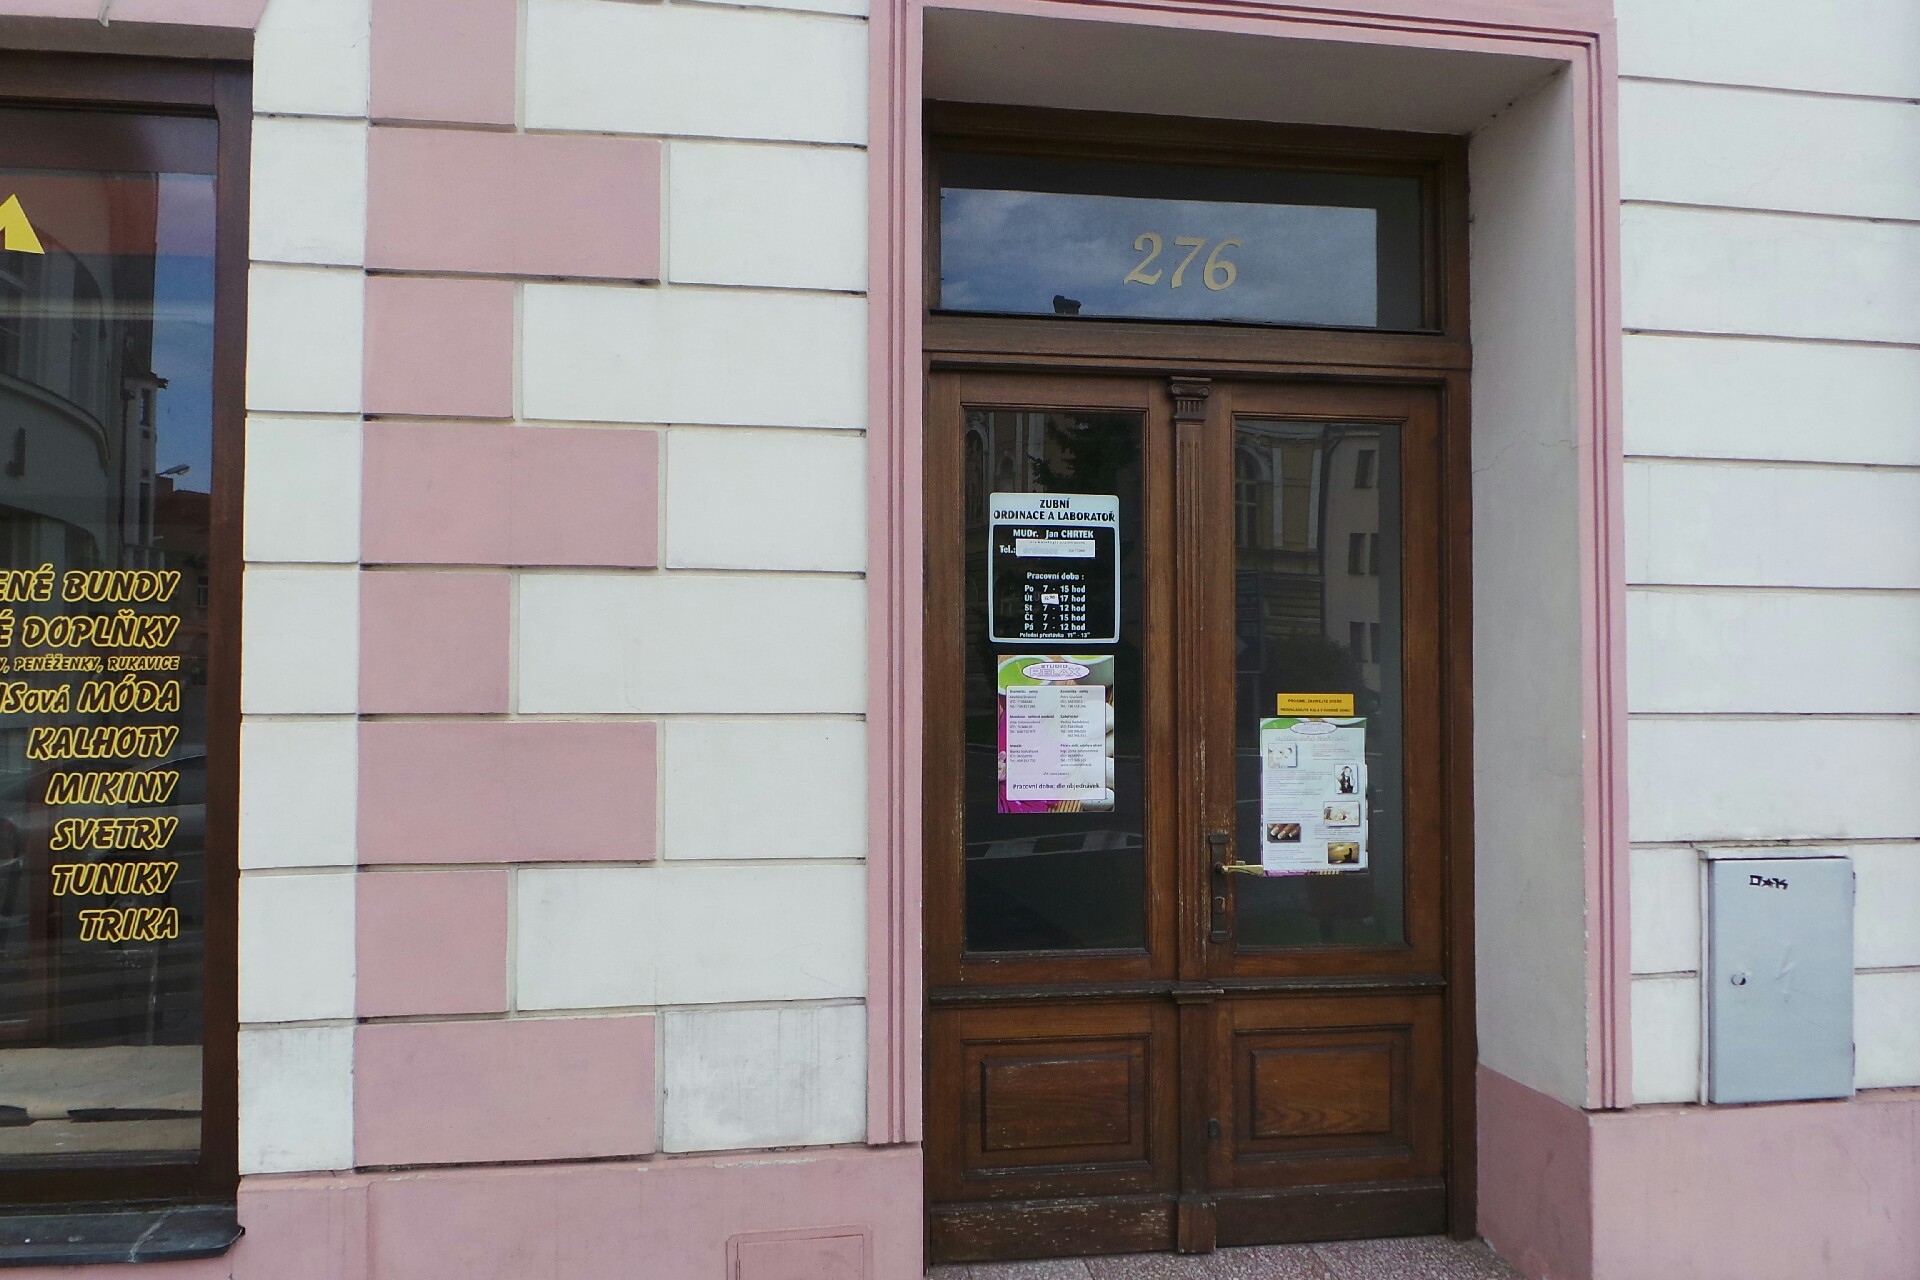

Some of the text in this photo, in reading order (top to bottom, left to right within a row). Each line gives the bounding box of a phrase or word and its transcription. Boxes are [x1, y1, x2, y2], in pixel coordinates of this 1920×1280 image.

[1122, 232, 1245, 292] 276
[1040, 498, 1070, 509] ZUBNÍ
[993, 510, 1115, 522] ORDINACE A LABORATOŘ
[1013, 529, 1094, 540] MUDr. Jan CHRTEK
[1026, 572, 1060, 580] Pracovní
[62, 570, 181, 602] BUNDY
[1024, 585, 1034, 593] Po
[1043, 585, 1049, 593] 7
[1060, 585, 1069, 593] 15
[1071, 585, 1086, 593] hod
[1024, 593, 1033, 602] Út
[1071, 594, 1086, 602] hod
[1024, 604, 1033, 612] St
[1043, 604, 1049, 612] 7
[1060, 604, 1069, 612] 12
[1071, 604, 1086, 612] hod
[1024, 612, 1034, 621] Čt
[1060, 613, 1069, 621] 15
[1071, 613, 1086, 621] hod
[22, 609, 181, 650] DOPLŇKY
[1024, 623, 1034, 631] Pá
[1043, 623, 1049, 631] 7
[1060, 623, 1069, 631] 12
[1071, 623, 1086, 631] hod
[14, 654, 103, 673] PENĚŽENKY,
[108, 656, 180, 671] RUKAVICE
[1030, 669, 1082, 677] RELAX
[77, 674, 180, 712] MÓDA
[26, 725, 179, 760] KALHOTY
[45, 771, 179, 805] MIKINY
[50, 817, 179, 850] SVETRY
[52, 862, 179, 896] TUNIKY
[79, 907, 179, 943] TRIKA
